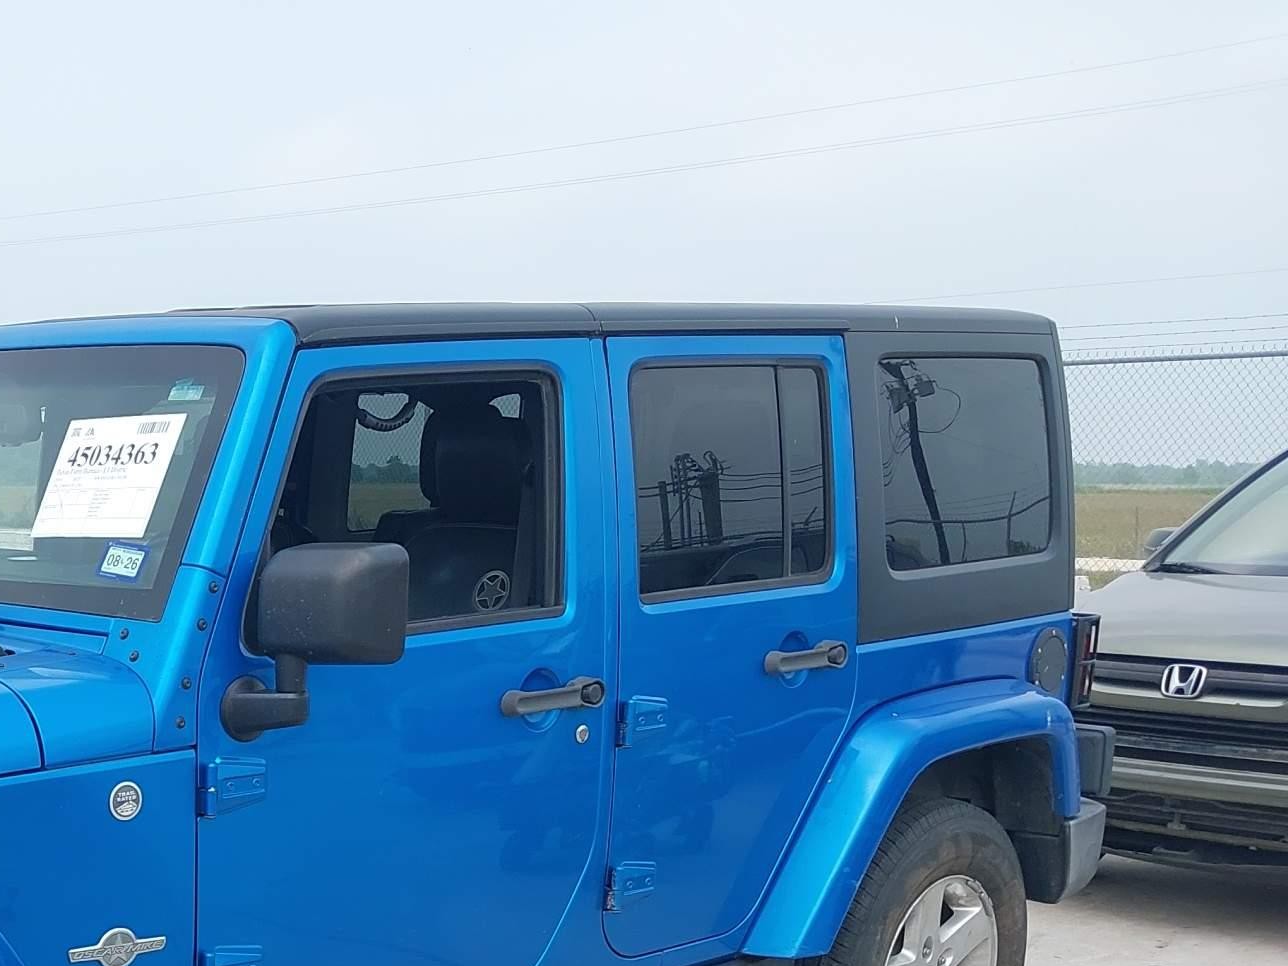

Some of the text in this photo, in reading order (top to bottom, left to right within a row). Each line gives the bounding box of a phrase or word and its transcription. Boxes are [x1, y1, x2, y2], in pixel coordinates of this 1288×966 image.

[67, 442, 159, 467] 45034363
[106, 554, 140, 570] 08 26
[72, 939, 163, 960] OSCAR MIKE
